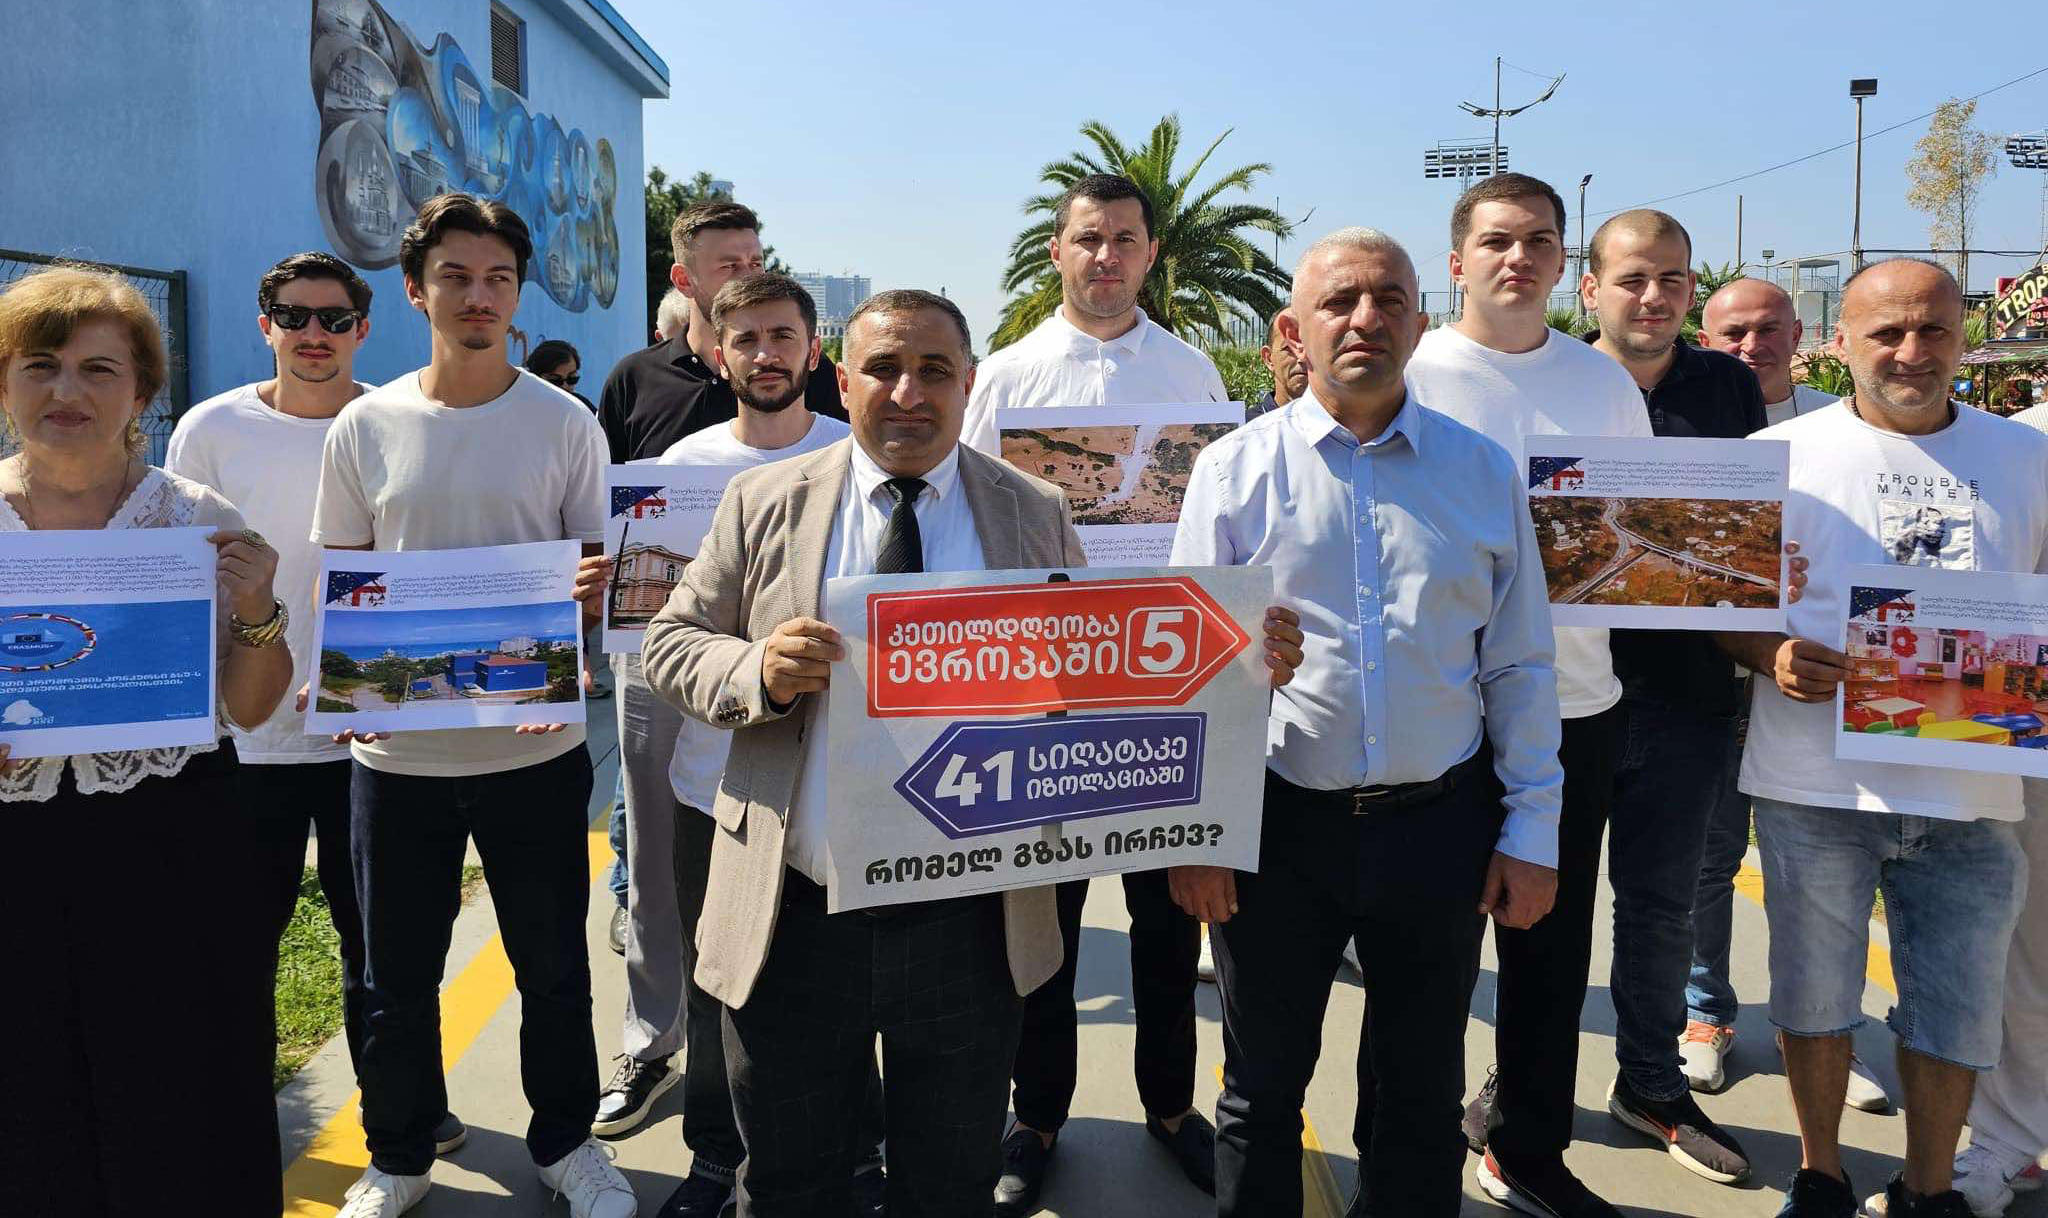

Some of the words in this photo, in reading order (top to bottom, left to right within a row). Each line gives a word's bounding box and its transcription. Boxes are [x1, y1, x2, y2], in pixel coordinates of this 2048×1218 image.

[1877, 473, 1979, 490] TROUBLE
[1877, 484, 1980, 501] MAKER
[888, 614, 1121, 647] კეთილდღეობა
[888, 640, 1119, 684] ევროპაში
[1138, 610, 1187, 674] 5
[1028, 736, 1188, 773] სიღატაკე
[934, 750, 1015, 807] 41
[1026, 767, 1185, 799] იზოლაციაში
[865, 845, 1001, 886] რომელ
[1014, 837, 1093, 868] გზას
[1105, 823, 1224, 856] ირჩევ?
